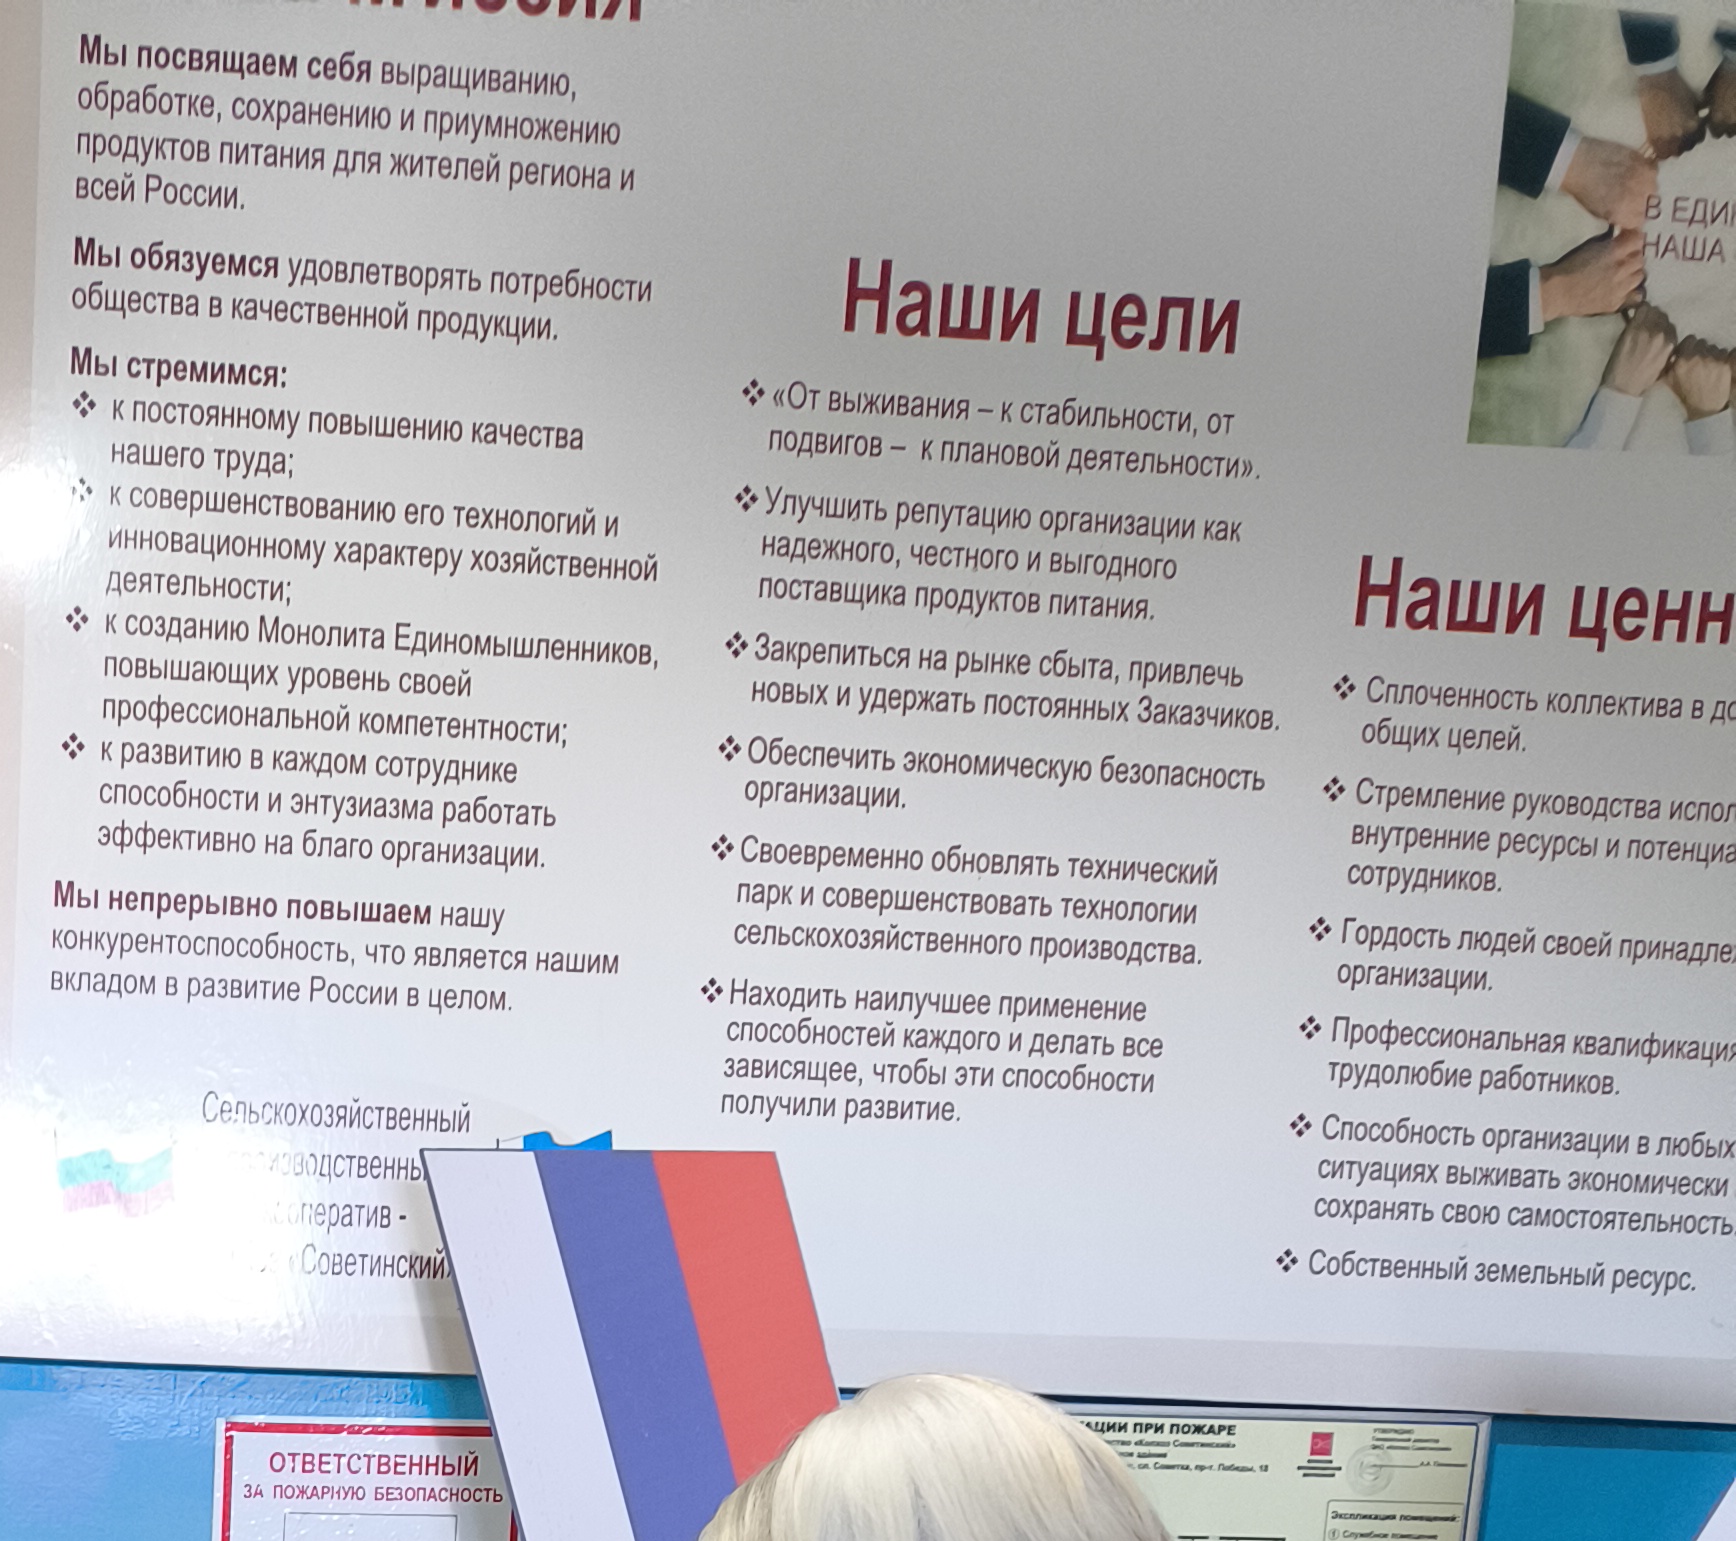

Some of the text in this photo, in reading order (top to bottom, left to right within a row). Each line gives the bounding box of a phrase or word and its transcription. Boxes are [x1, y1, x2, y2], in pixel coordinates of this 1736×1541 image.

[79, 33, 577, 103] Мы посвящаем себя выращиванию,
[77, 79, 621, 146] обработке, сохранению и приумножению
[75, 171, 245, 211] всей России.
[1645, 194, 1736, 229] В ЕДИ
[73, 235, 652, 304] Мы обязуемся удовлетворять потребности
[1642, 232, 1726, 263] НАША
[843, 256, 1241, 362] Наши цели
[70, 345, 288, 389] Мы стремимся:
[111, 442, 294, 480] нашего труда;
[764, 485, 1243, 545] Улучшить репутацию организации как
[108, 527, 658, 583] инновационному характеру хозяйственной
[761, 534, 1178, 583] надежного, честного и выгодного
[105, 570, 292, 608] деятельности;
[758, 576, 1155, 621] поставщика продуктов питания.
[1354, 554, 1736, 653] Наши ценн
[103, 655, 472, 698] повышающих уровень своей
[754, 631, 1244, 690] Закрепиться на рынке сбыта, привлечь
[1366, 675, 1539, 712] Сплоченность
[1546, 692, 1683, 719] коллектива
[1690, 698, 1705, 720] в
[102, 693, 568, 750] профессиональной компетентности;
[1361, 716, 1527, 756] общих целей.
[747, 735, 1266, 792] Обеспечить экономическую безопасность
[99, 779, 557, 830] способности и энтузиазма работать
[744, 779, 906, 815] организации.
[1355, 776, 1506, 813] Стремление
[1511, 792, 1662, 823] руководства
[740, 834, 1219, 886] Своевременно обновлять технический
[1347, 863, 1502, 895] сотрудников.
[53, 879, 506, 937] Мы непрерывно повышаем нашу
[52, 928, 620, 975] конкурентоспособность, что является нашим
[733, 923, 1202, 967] сельскохозяйственного производства.
[1341, 916, 1736, 967] Гордость людей своей принадле
[729, 977, 1147, 1023] Находить наилучшее применение
[1337, 963, 1493, 997] организации.
[1331, 1015, 1567, 1054] Профессиональная
[1327, 1059, 1620, 1096] трудолюбие работников.
[202, 1090, 471, 1133] Сельскохозяйственный
[720, 1093, 961, 1125] получили развитие.
[1317, 1158, 1730, 1198] ситуациях выживать экономически
[1313, 1197, 1435, 1226] сохранять
[1441, 1202, 1501, 1226] свою
[1308, 1248, 1696, 1297] Собственный земельный ресурс.
[1133, 1422, 1164, 1434] ПРИ
[1169, 1423, 1237, 1436] ПОЖАРЕ
[269, 1450, 479, 1477] ОТВЕТСТВЕННЫЙ
[243, 1484, 504, 1503] ЗА ПОЖАРНУЮ БЕЗОПАСНОСТЬ
